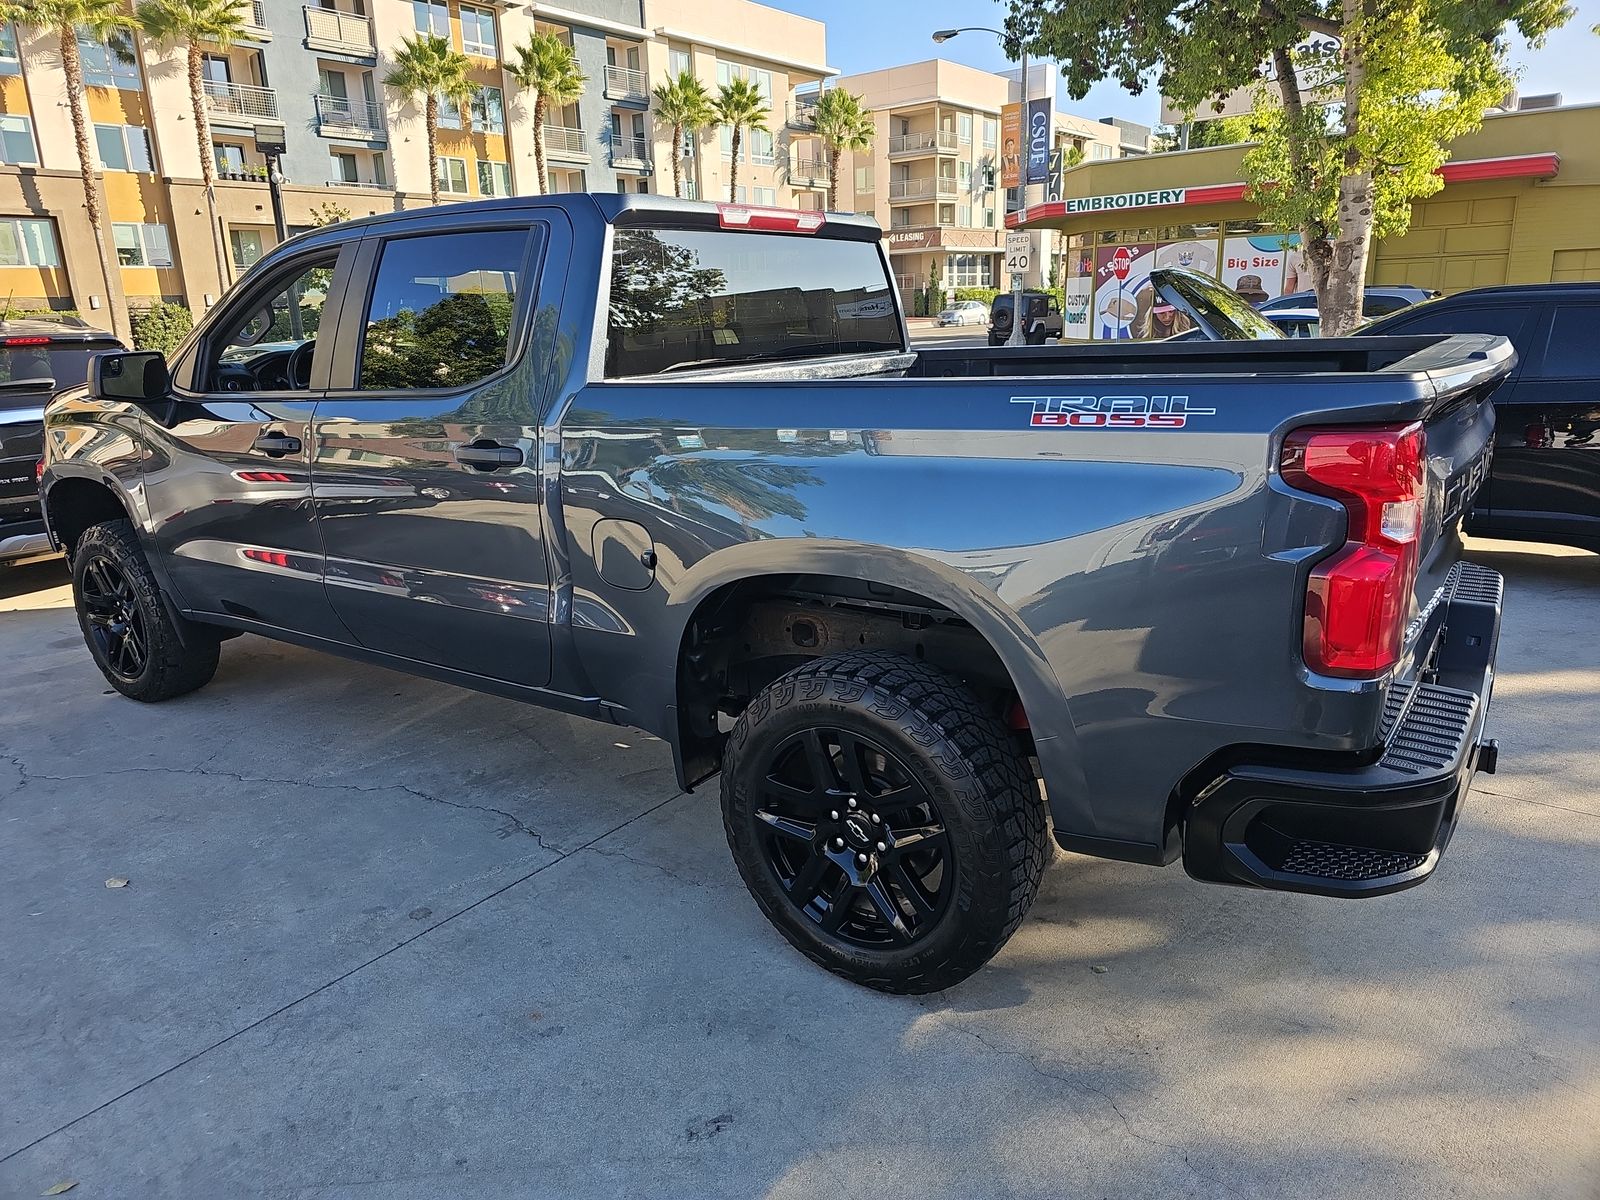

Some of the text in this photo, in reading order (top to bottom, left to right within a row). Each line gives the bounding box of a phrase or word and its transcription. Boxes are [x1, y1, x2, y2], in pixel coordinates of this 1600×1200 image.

[1297, 39, 1336, 57] ats
[1031, 111, 1047, 164] CSUF
[1066, 189, 1184, 213] EMBROIDERY
[896, 232, 924, 242] LEASING
[1007, 236, 1029, 244] SPEED
[1009, 245, 1026, 253] LIMIT
[1007, 255, 1028, 269] 40
[1114, 257, 1130, 270] STOP
[1227, 257, 1279, 271] Big Size
[1067, 294, 1090, 306] CUSTOM
[1068, 312, 1087, 324] ORDER
[1010, 396, 1216, 415] TRAIL
[1030, 412, 1187, 428] BOSS
